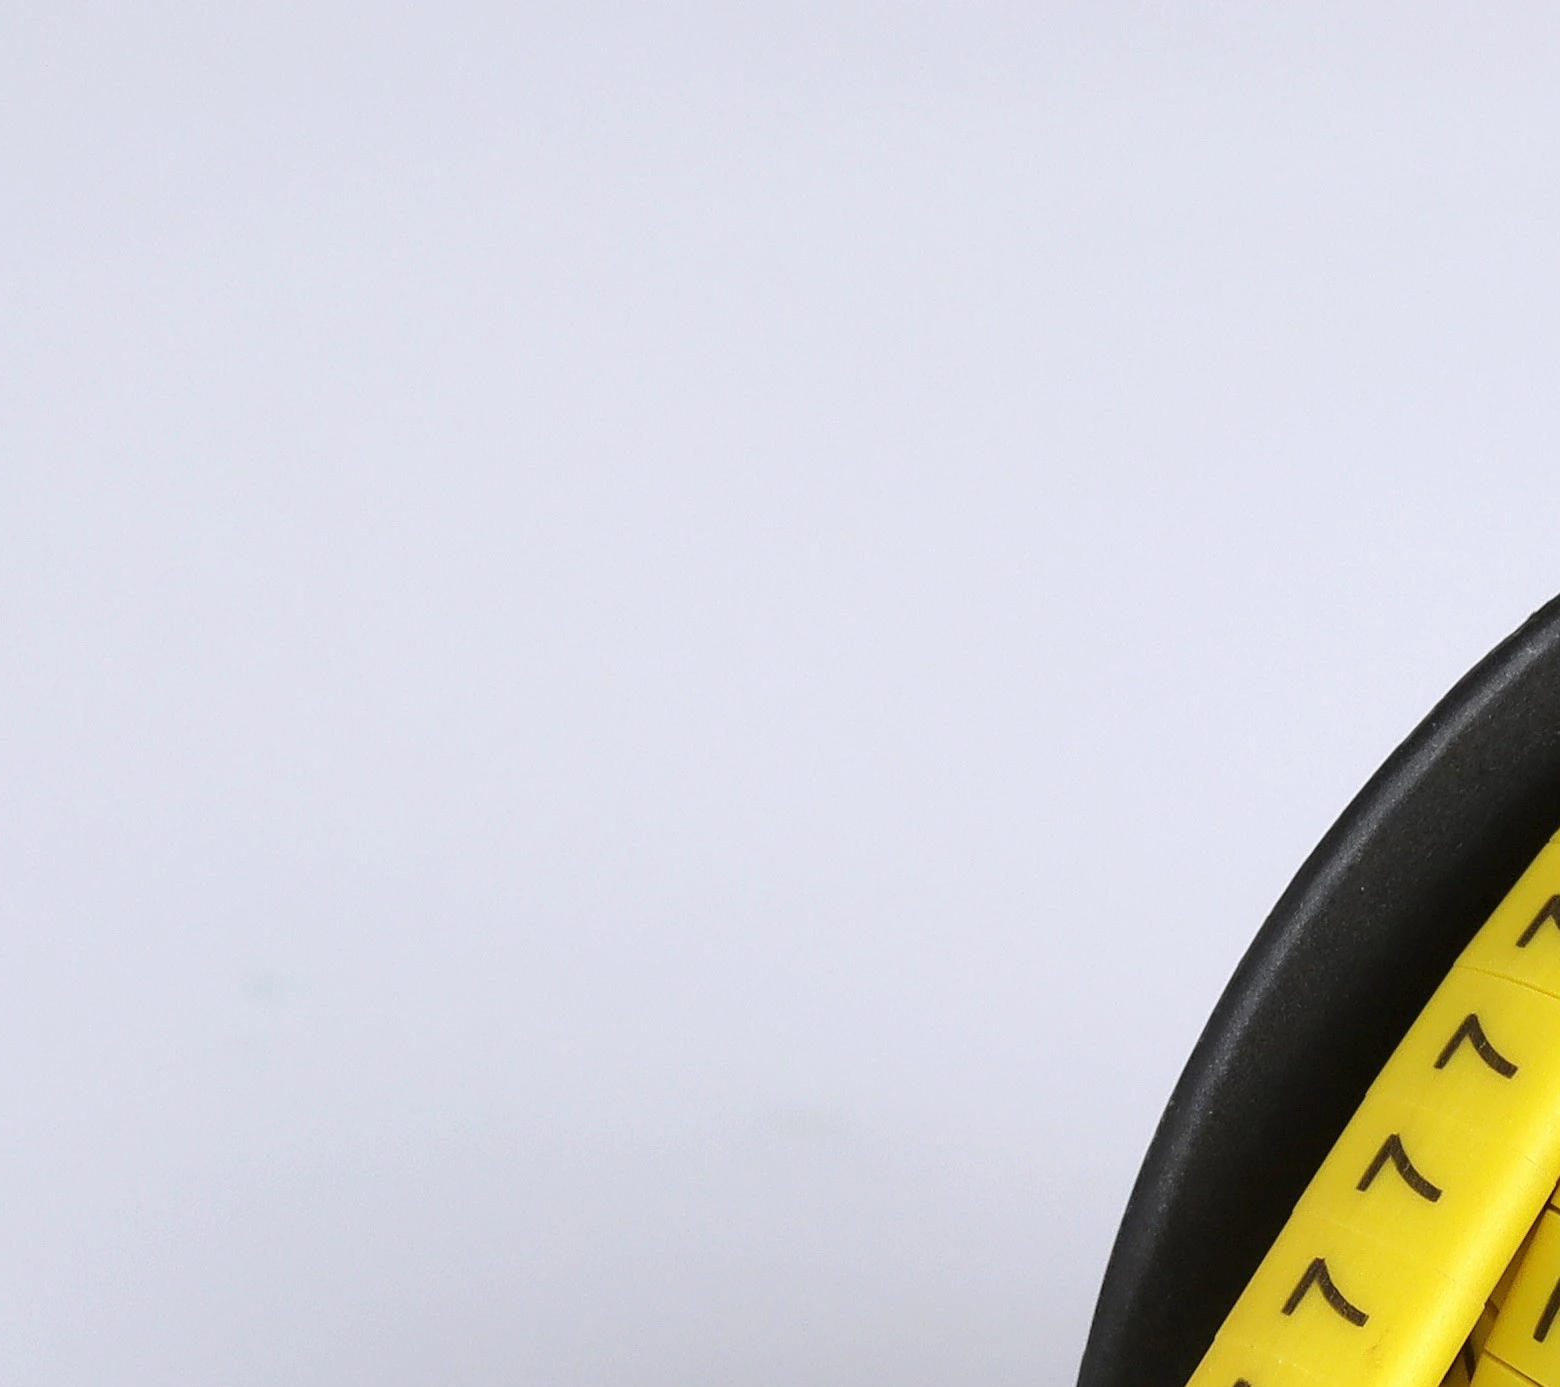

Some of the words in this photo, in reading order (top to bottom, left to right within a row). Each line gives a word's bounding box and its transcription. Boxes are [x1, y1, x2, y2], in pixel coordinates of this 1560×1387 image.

[1280, 1256, 1370, 1328] 7
[1355, 1132, 1443, 1204] 7
[1432, 1012, 1519, 1080] 7
